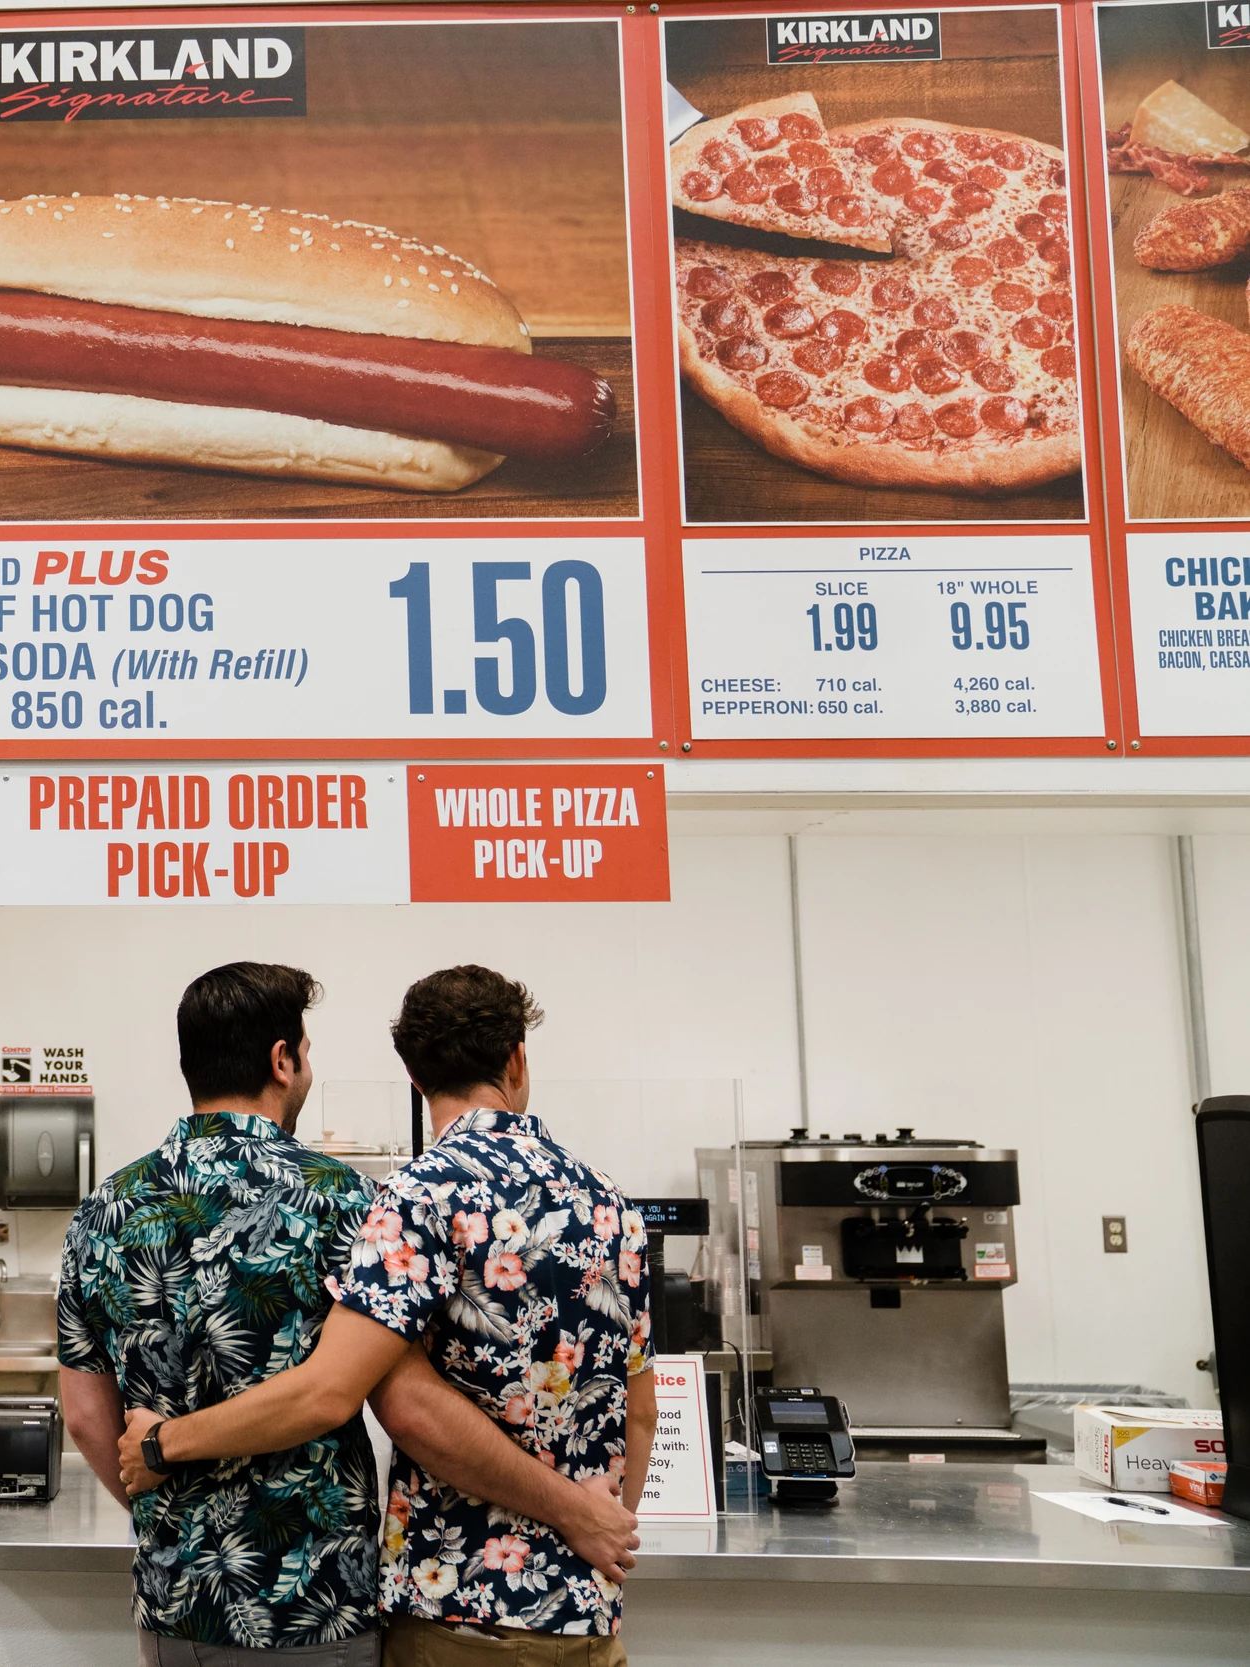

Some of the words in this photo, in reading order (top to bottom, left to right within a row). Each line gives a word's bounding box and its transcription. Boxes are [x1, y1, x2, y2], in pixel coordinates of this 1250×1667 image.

[776, 17, 934, 45] KIRKLAND
[0, 37, 293, 84] KIRKLAND
[778, 43, 934, 64] Signature
[0, 82, 293, 123] Signature
[859, 546, 911, 561] PIZZA
[33, 550, 169, 585] PLUS
[815, 581, 869, 597] SLICE
[970, 580, 1039, 595] WHOLE
[32, 594, 114, 633] HOT
[129, 593, 214, 632] DOG
[388, 558, 607, 717] 1.50
[806, 602, 879, 653] 1.99
[950, 601, 1030, 651] 9.95
[1159, 629, 1213, 647] CHICKEN
[1217, 629, 1250, 647] BREA
[112, 649, 198, 688] (With
[208, 648, 308, 687] Refill)
[1158, 651, 1206, 671] BACON,
[700, 678, 782, 693] CHEESE:
[816, 677, 846, 693] 710
[851, 677, 882, 693] cal.
[953, 676, 999, 694] 4,260
[1005, 676, 1036, 691] cal.
[11, 690, 83, 730] 850
[99, 690, 167, 730] cal.
[701, 700, 814, 716] PEPPERONI:
[817, 699, 847, 715] 650
[853, 699, 884, 714] cal.
[955, 699, 1001, 716] 3,880
[1006, 698, 1037, 714] cal.
[28, 774, 210, 830] PREPAID
[229, 773, 368, 830] ORDER
[435, 788, 541, 828] WHOLE
[553, 788, 640, 828] PIZZA
[107, 841, 290, 898] PICK-UP
[474, 837, 602, 879] PICK-UP
[43, 1048, 84, 1058] WASH
[39, 1073, 88, 1083] HANDS
[44, 1061, 83, 1071] YOUR
[648, 1205, 661, 1213] YOU
[662, 1441, 689, 1451] with:
[649, 1457, 674, 1469] Soy,
